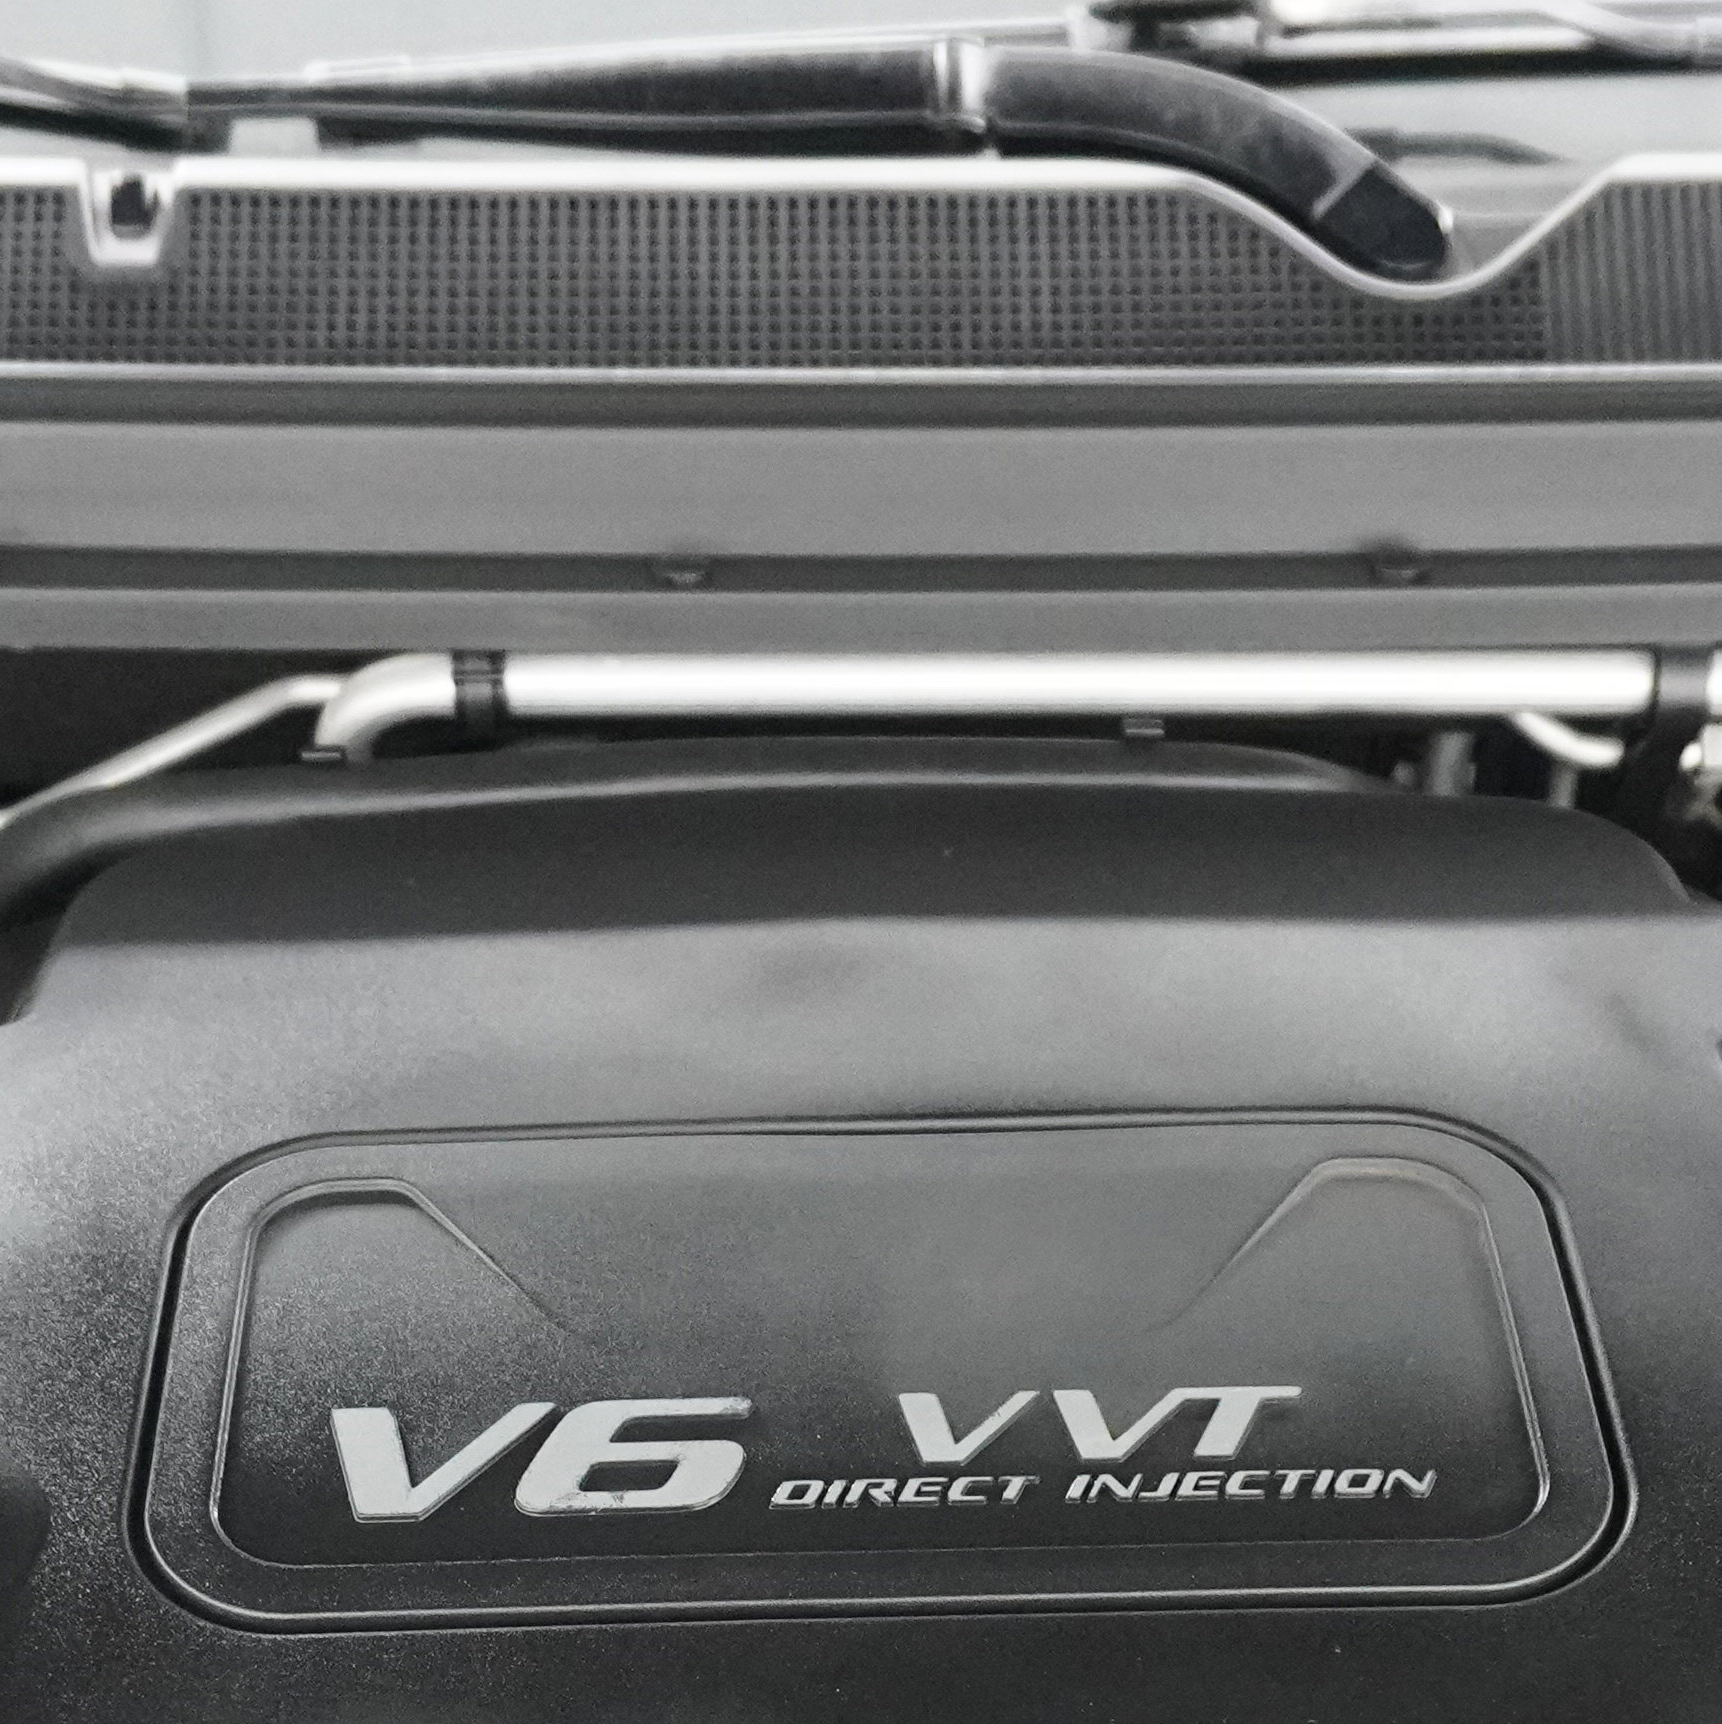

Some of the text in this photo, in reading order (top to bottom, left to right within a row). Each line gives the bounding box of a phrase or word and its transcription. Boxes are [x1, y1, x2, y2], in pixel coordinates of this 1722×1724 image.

[330, 1395, 754, 1525] V6
[895, 1384, 1303, 1466] VVT
[769, 1466, 1439, 1509] DIRECT INJECTION
